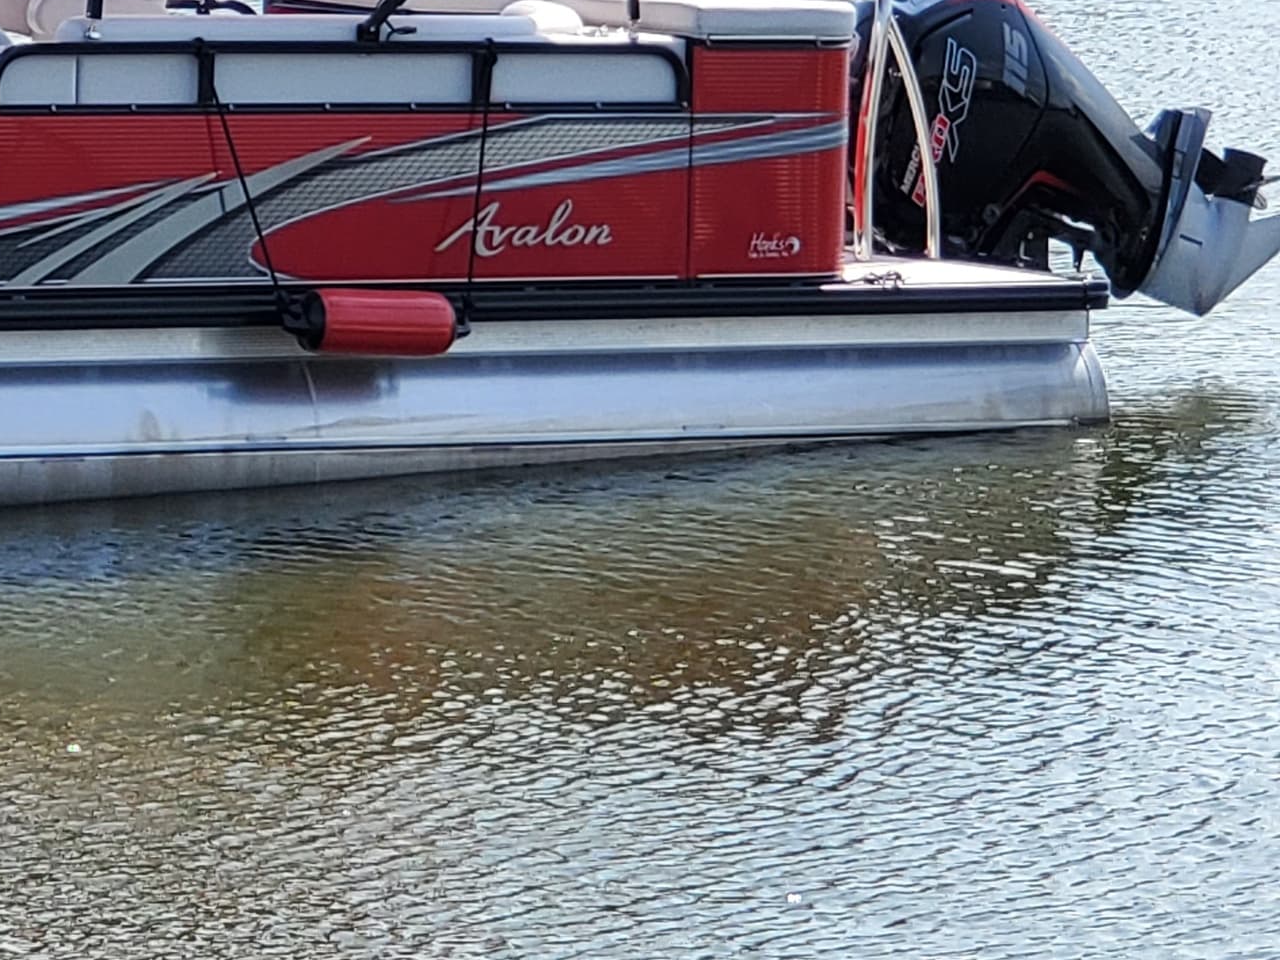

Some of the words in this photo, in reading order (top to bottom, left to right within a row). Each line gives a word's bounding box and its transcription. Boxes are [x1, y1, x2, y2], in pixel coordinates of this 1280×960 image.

[1002, 21, 1029, 97] 115
[938, 37, 977, 163] XS
[434, 198, 612, 257] Avalon
